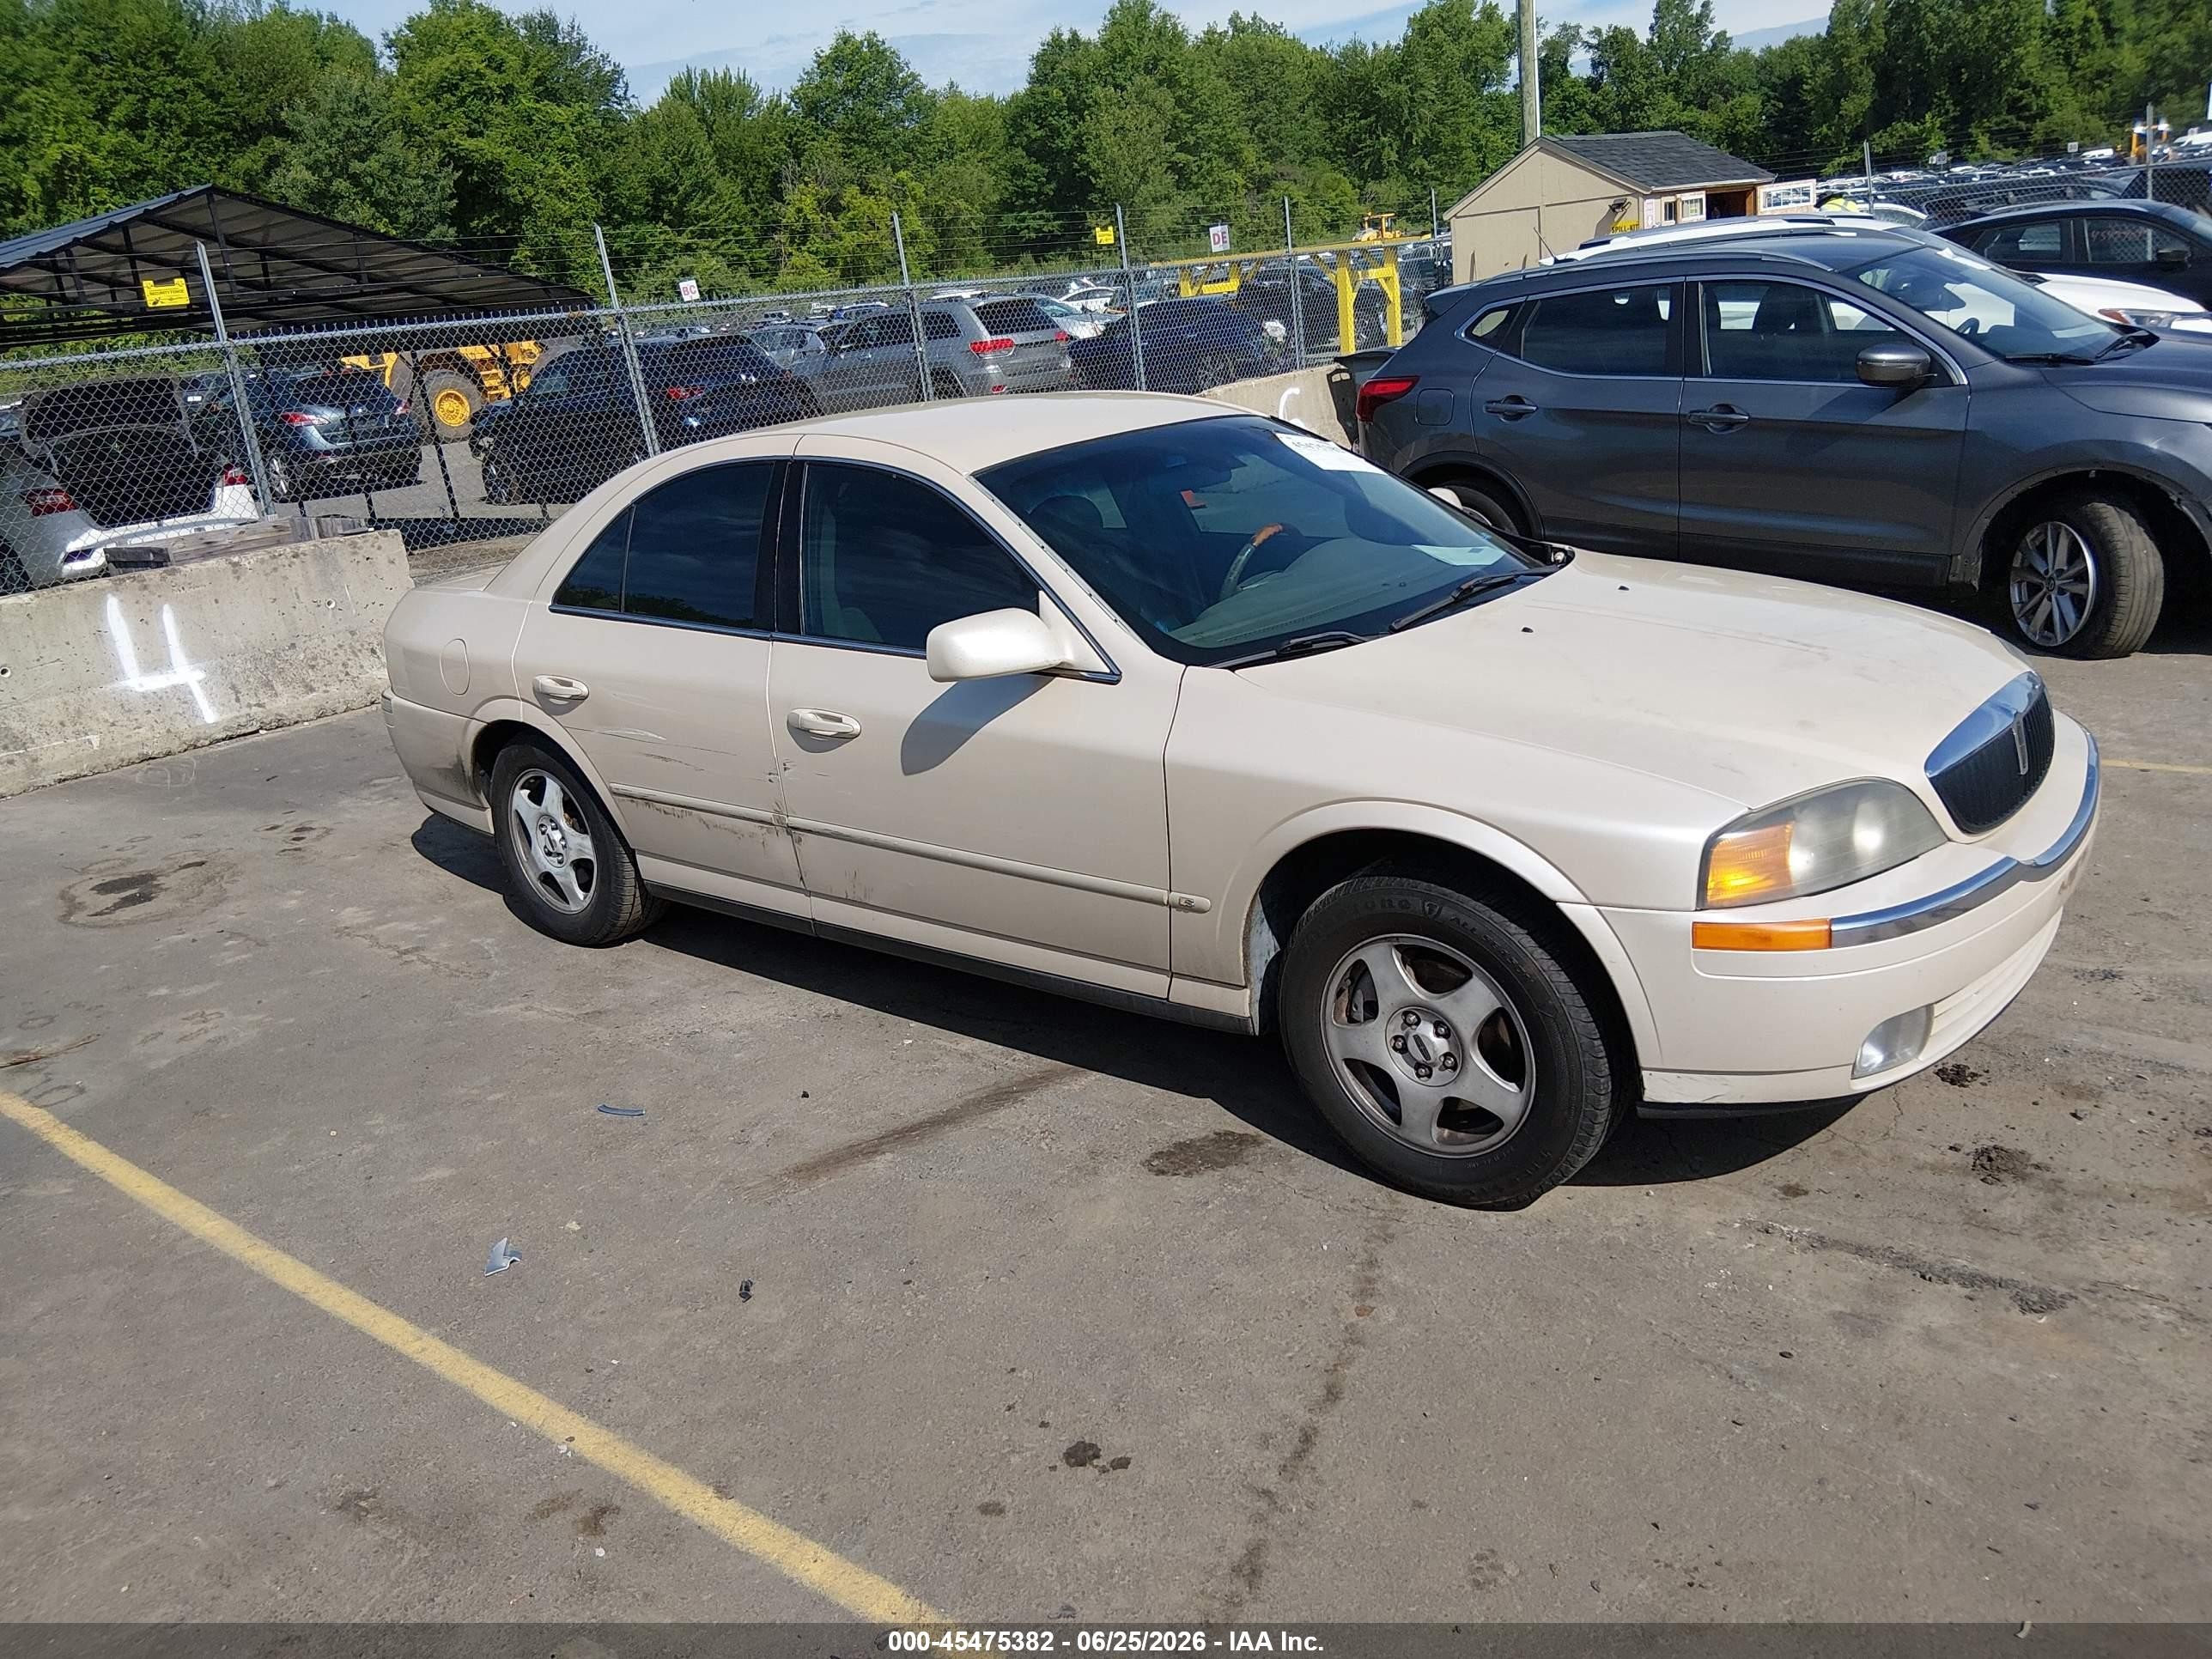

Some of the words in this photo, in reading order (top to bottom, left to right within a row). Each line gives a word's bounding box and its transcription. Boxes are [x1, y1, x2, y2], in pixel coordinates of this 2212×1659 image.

[1612, 223, 1640, 234] SPILL-KIT
[1212, 232, 1228, 245] DE
[683, 285, 696, 295] BC
